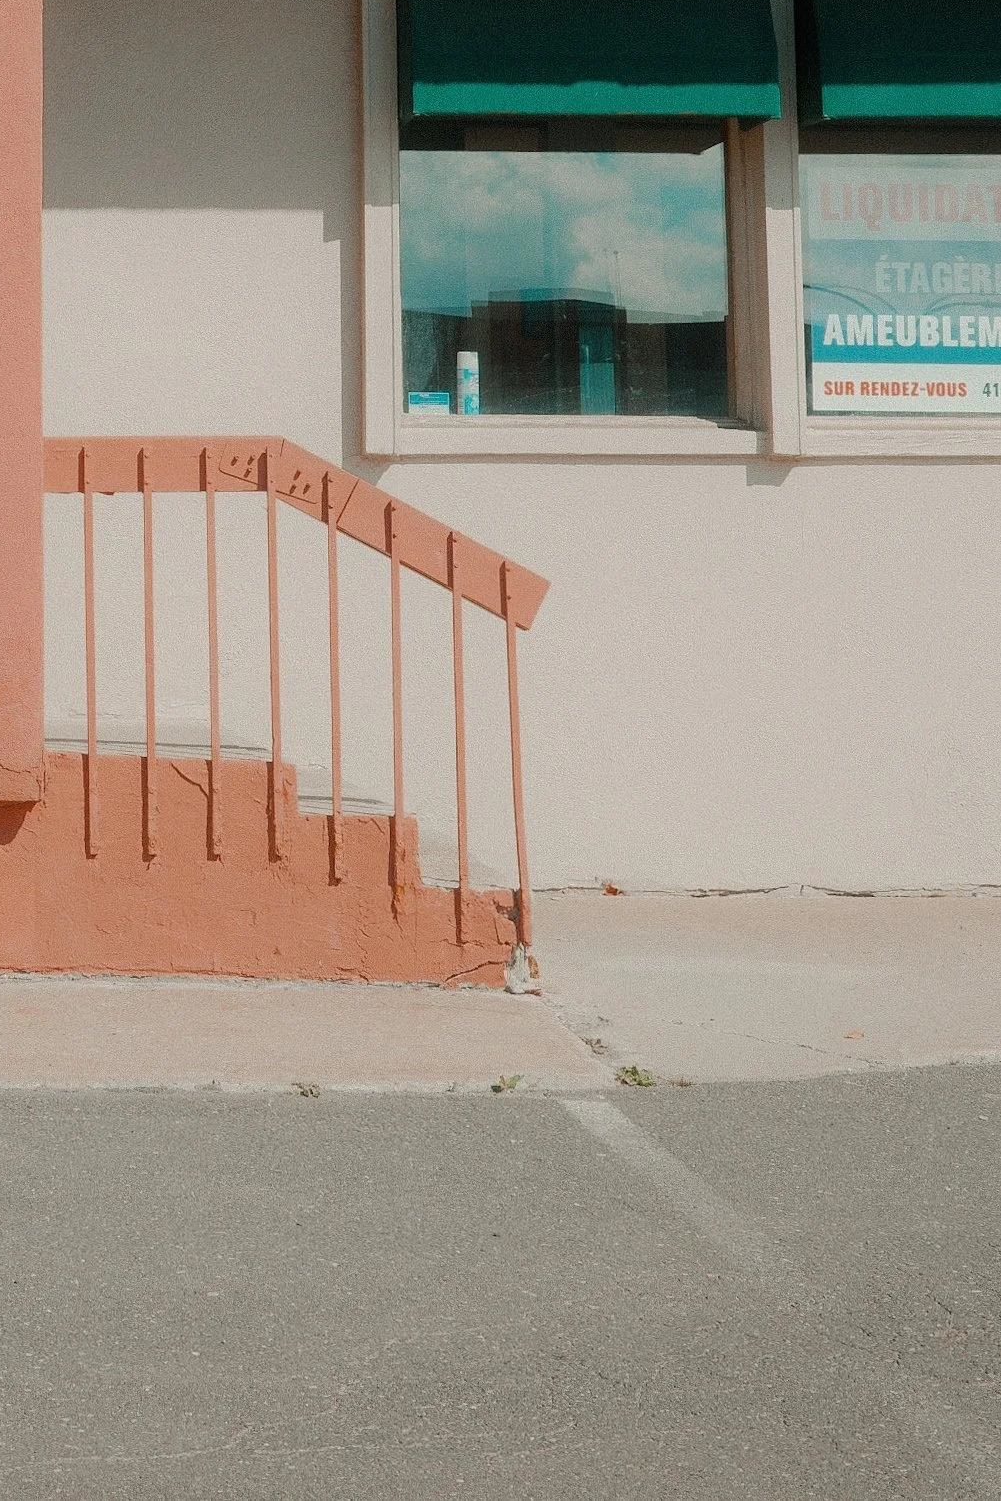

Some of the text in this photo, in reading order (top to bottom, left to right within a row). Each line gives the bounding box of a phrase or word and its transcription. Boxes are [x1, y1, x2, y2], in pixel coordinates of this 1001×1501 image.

[823, 313, 1001, 348] AMEUBLEM
[823, 380, 855, 397] SUR
[860, 381, 968, 398] RENDEZ-VOUS
